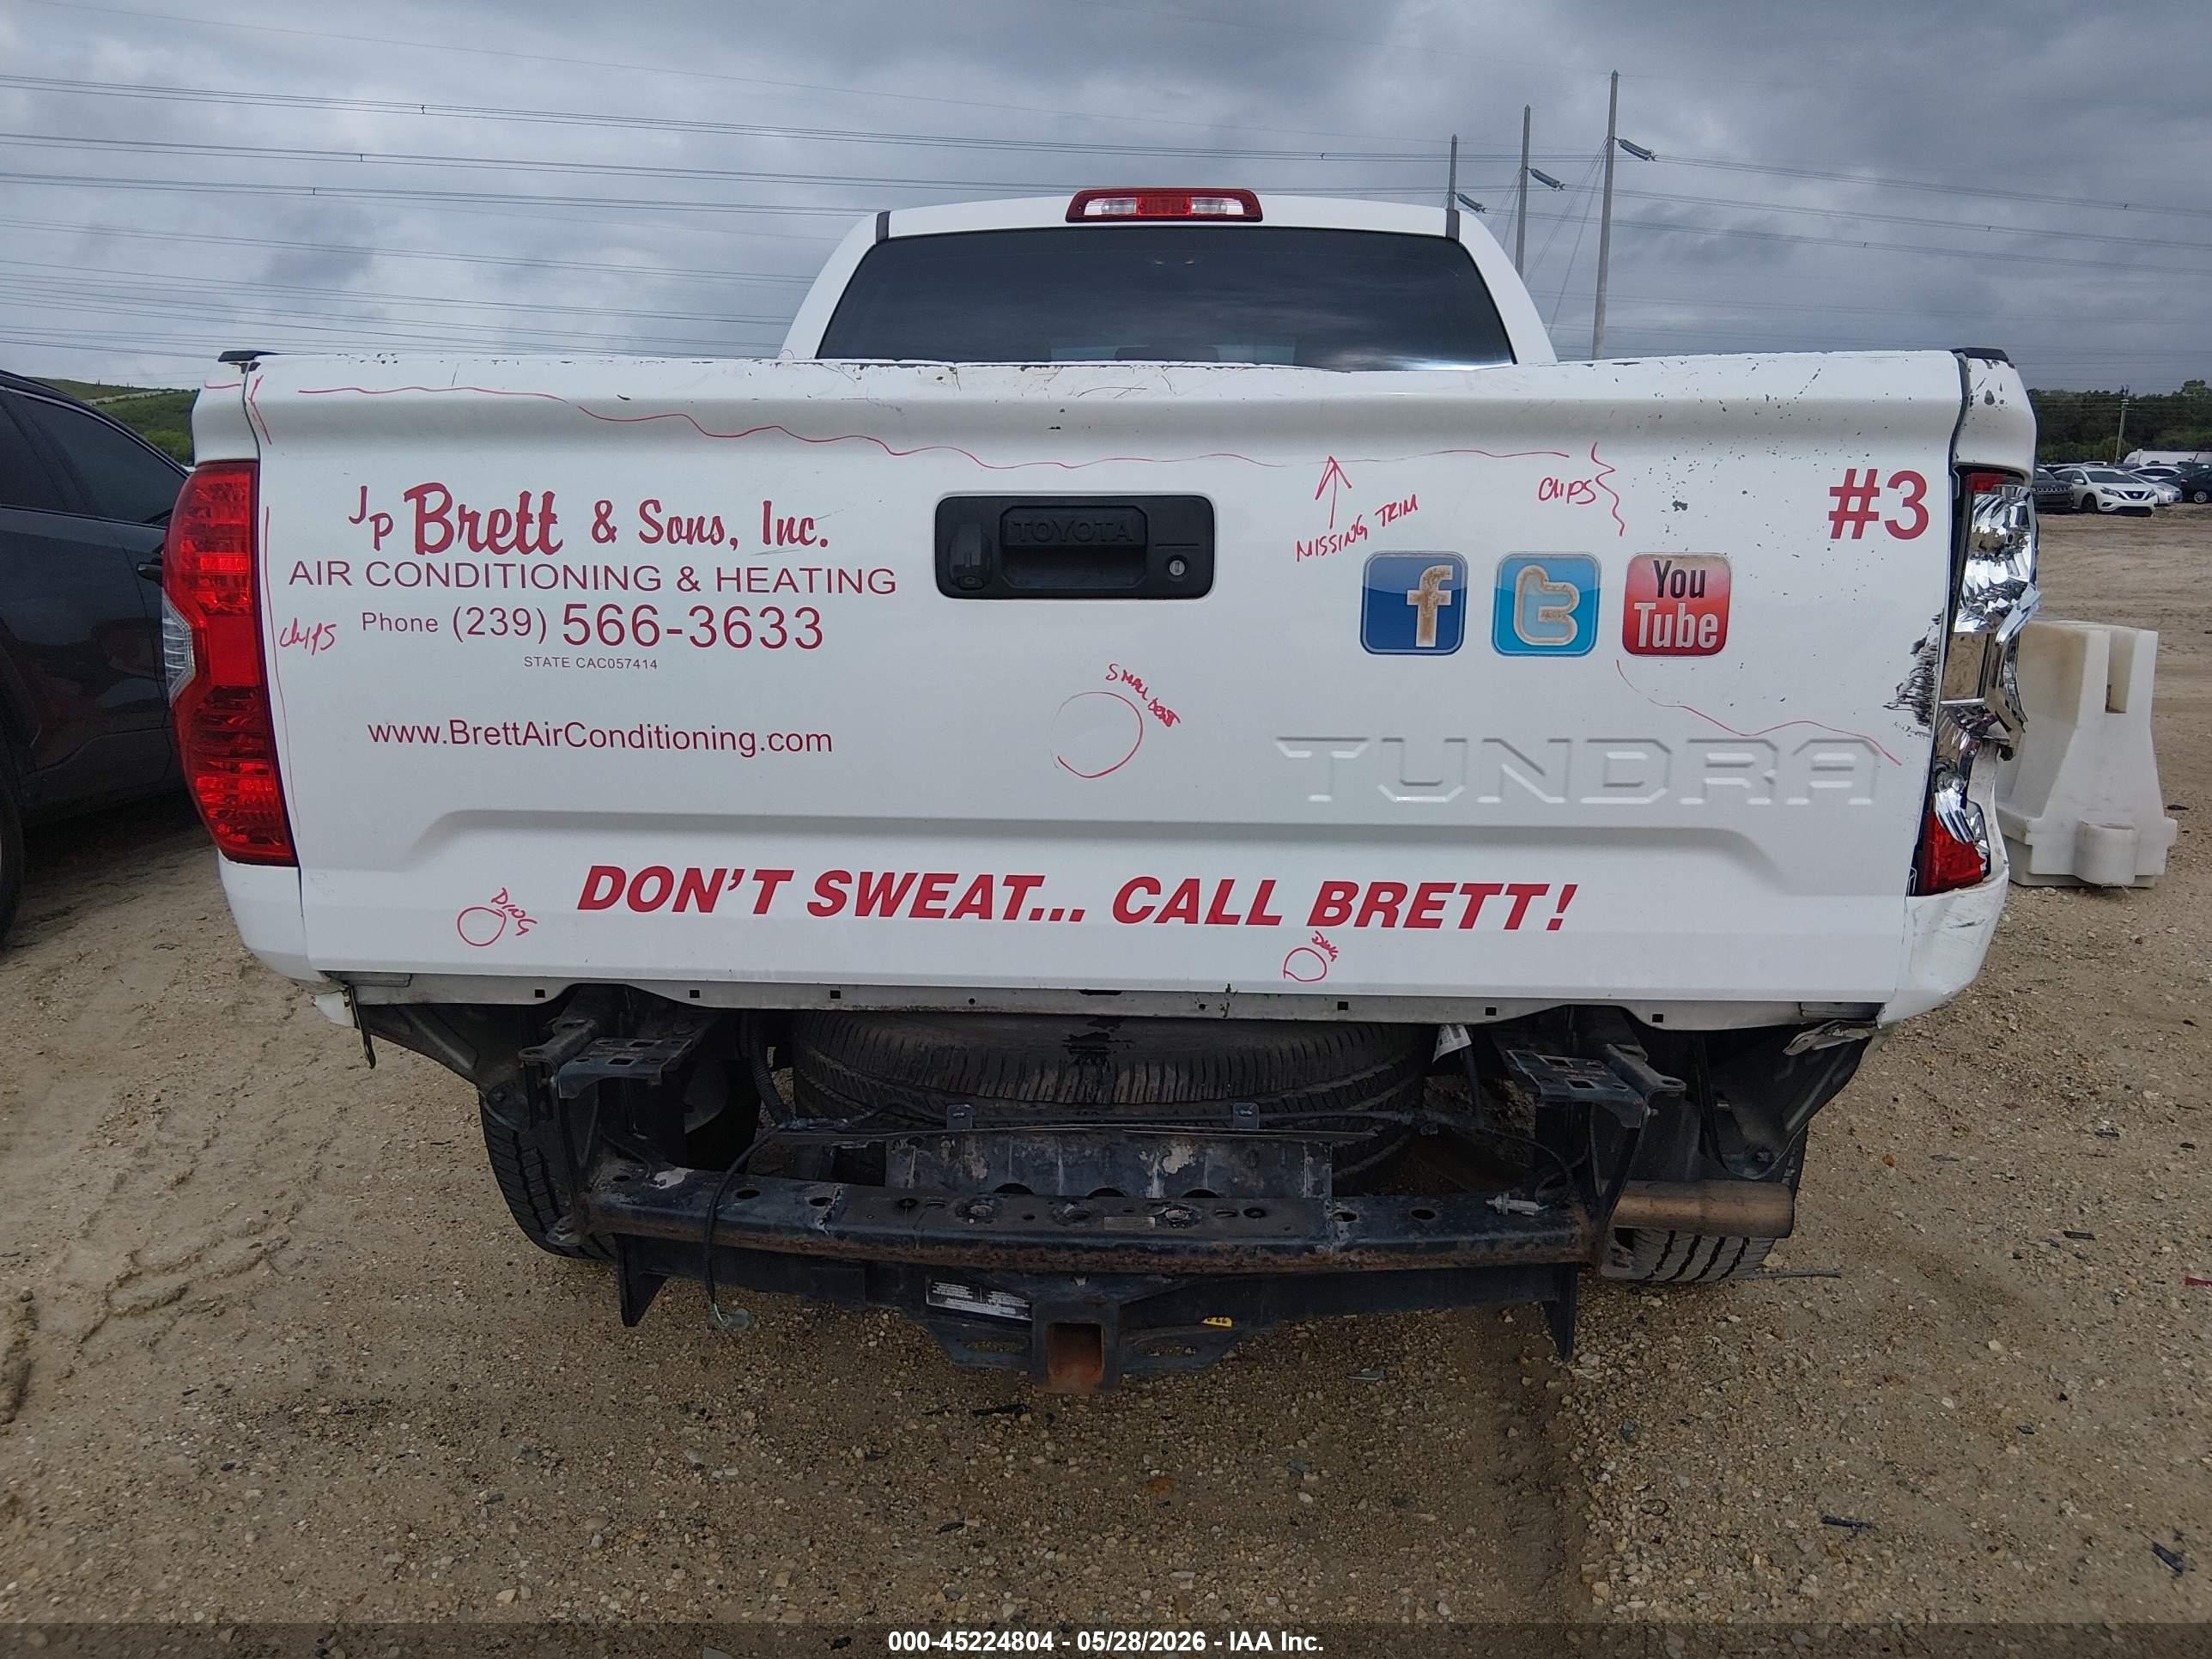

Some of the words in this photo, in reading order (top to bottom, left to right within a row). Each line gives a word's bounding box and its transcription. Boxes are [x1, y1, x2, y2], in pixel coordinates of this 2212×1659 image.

[404, 482, 564, 556] Brett
[592, 499, 617, 544] &
[638, 499, 738, 550] Sons,
[762, 501, 829, 549] Inc.
[1375, 494, 1419, 527] TRIM
[1828, 469, 1929, 540] #3
[1013, 520, 1134, 543] TOYOTA
[289, 560, 353, 586] AIR
[365, 562, 661, 592] CONDITIONING
[676, 565, 702, 592] &
[716, 566, 896, 595] HEATING
[1652, 559, 1706, 599] You
[362, 611, 439, 634] Phone
[453, 606, 547, 644] (239)
[562, 604, 823, 650] 566-3633
[1634, 603, 1718, 649] Tube
[524, 655, 571, 668] STATE
[575, 657, 658, 670] CAC057414
[368, 720, 833, 758] www.BrettAirConditioning.com
[1276, 736, 1879, 805] TUNDRA
[576, 865, 793, 915] DON'T
[806, 869, 1086, 923] SWEAT...
[1112, 876, 1284, 927] CALL
[1305, 880, 1579, 932] BRETT!
